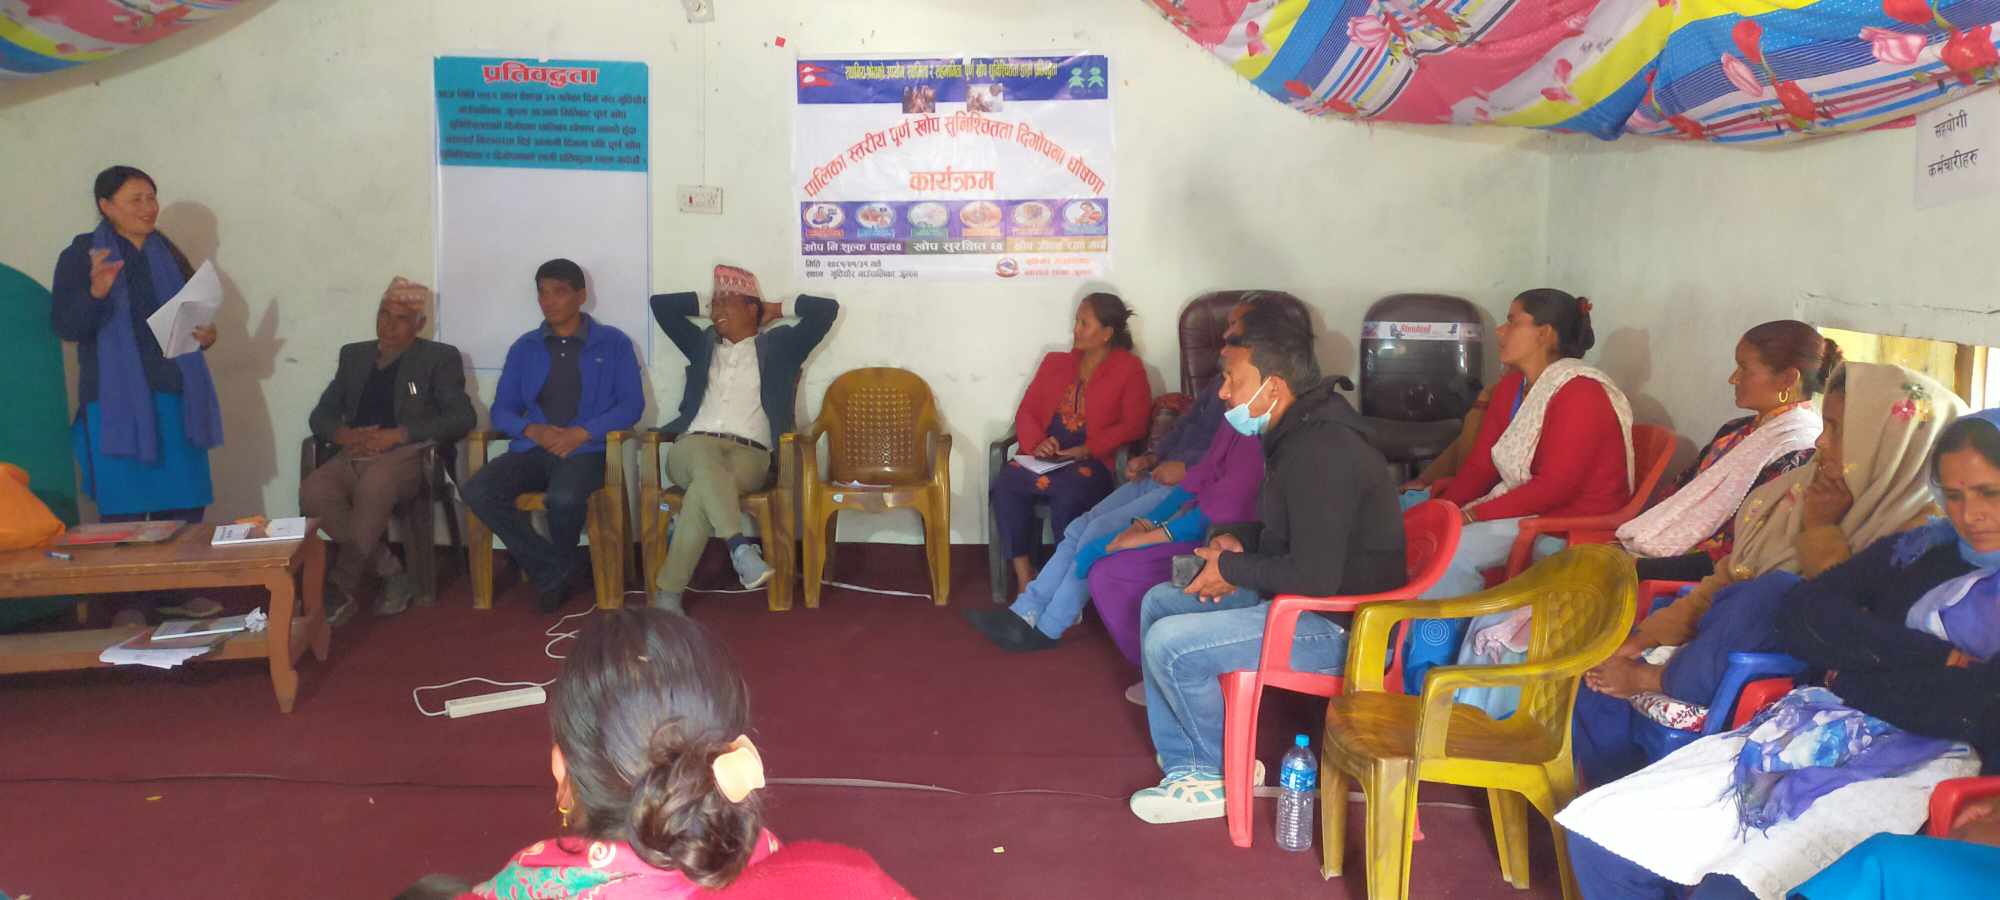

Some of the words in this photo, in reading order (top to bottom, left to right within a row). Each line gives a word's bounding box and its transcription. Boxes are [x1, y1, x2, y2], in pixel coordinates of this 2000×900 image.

[1934, 109, 1968, 138] सहयोगी
[803, 155, 847, 198] पालिका
[848, 131, 887, 165] स्तरीय
[889, 123, 911, 147] पूर्ण
[914, 115, 940, 137] खोप
[1015, 123, 1065, 166] दिगोपना
[1066, 153, 1106, 196] घोषणा
[909, 165, 996, 192] कार्यक्रम
[803, 241, 824, 252] खोप
[912, 240, 939, 251] खोप
